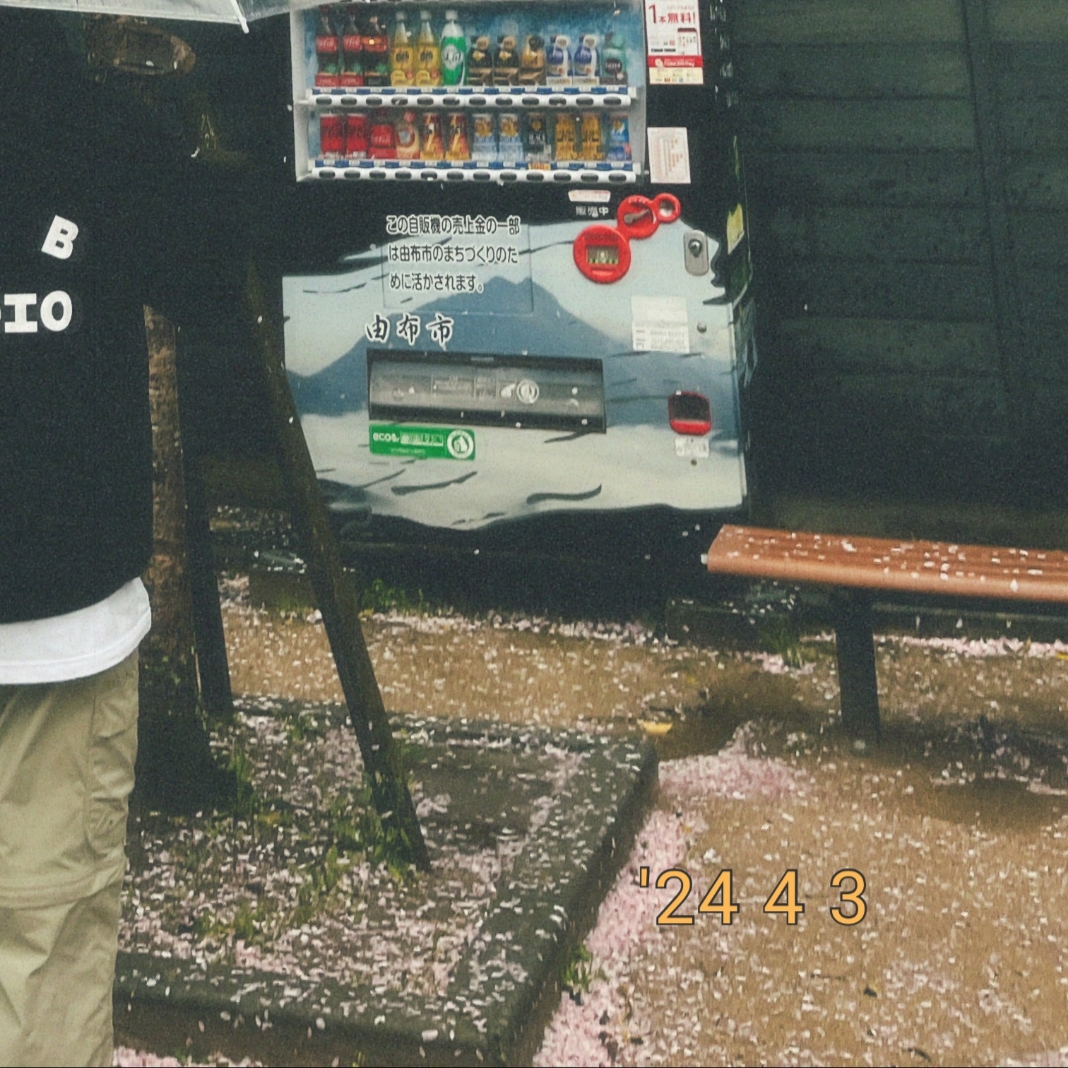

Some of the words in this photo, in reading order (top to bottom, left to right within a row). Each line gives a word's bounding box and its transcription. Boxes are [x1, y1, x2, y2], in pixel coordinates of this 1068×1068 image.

[386, 214, 521, 236] この自販機の売上金の一部
[388, 244, 519, 264] は由布市のまちづくりのた
[390, 272, 484, 292] めに活かされます。
[366, 313, 453, 345] 由布市
